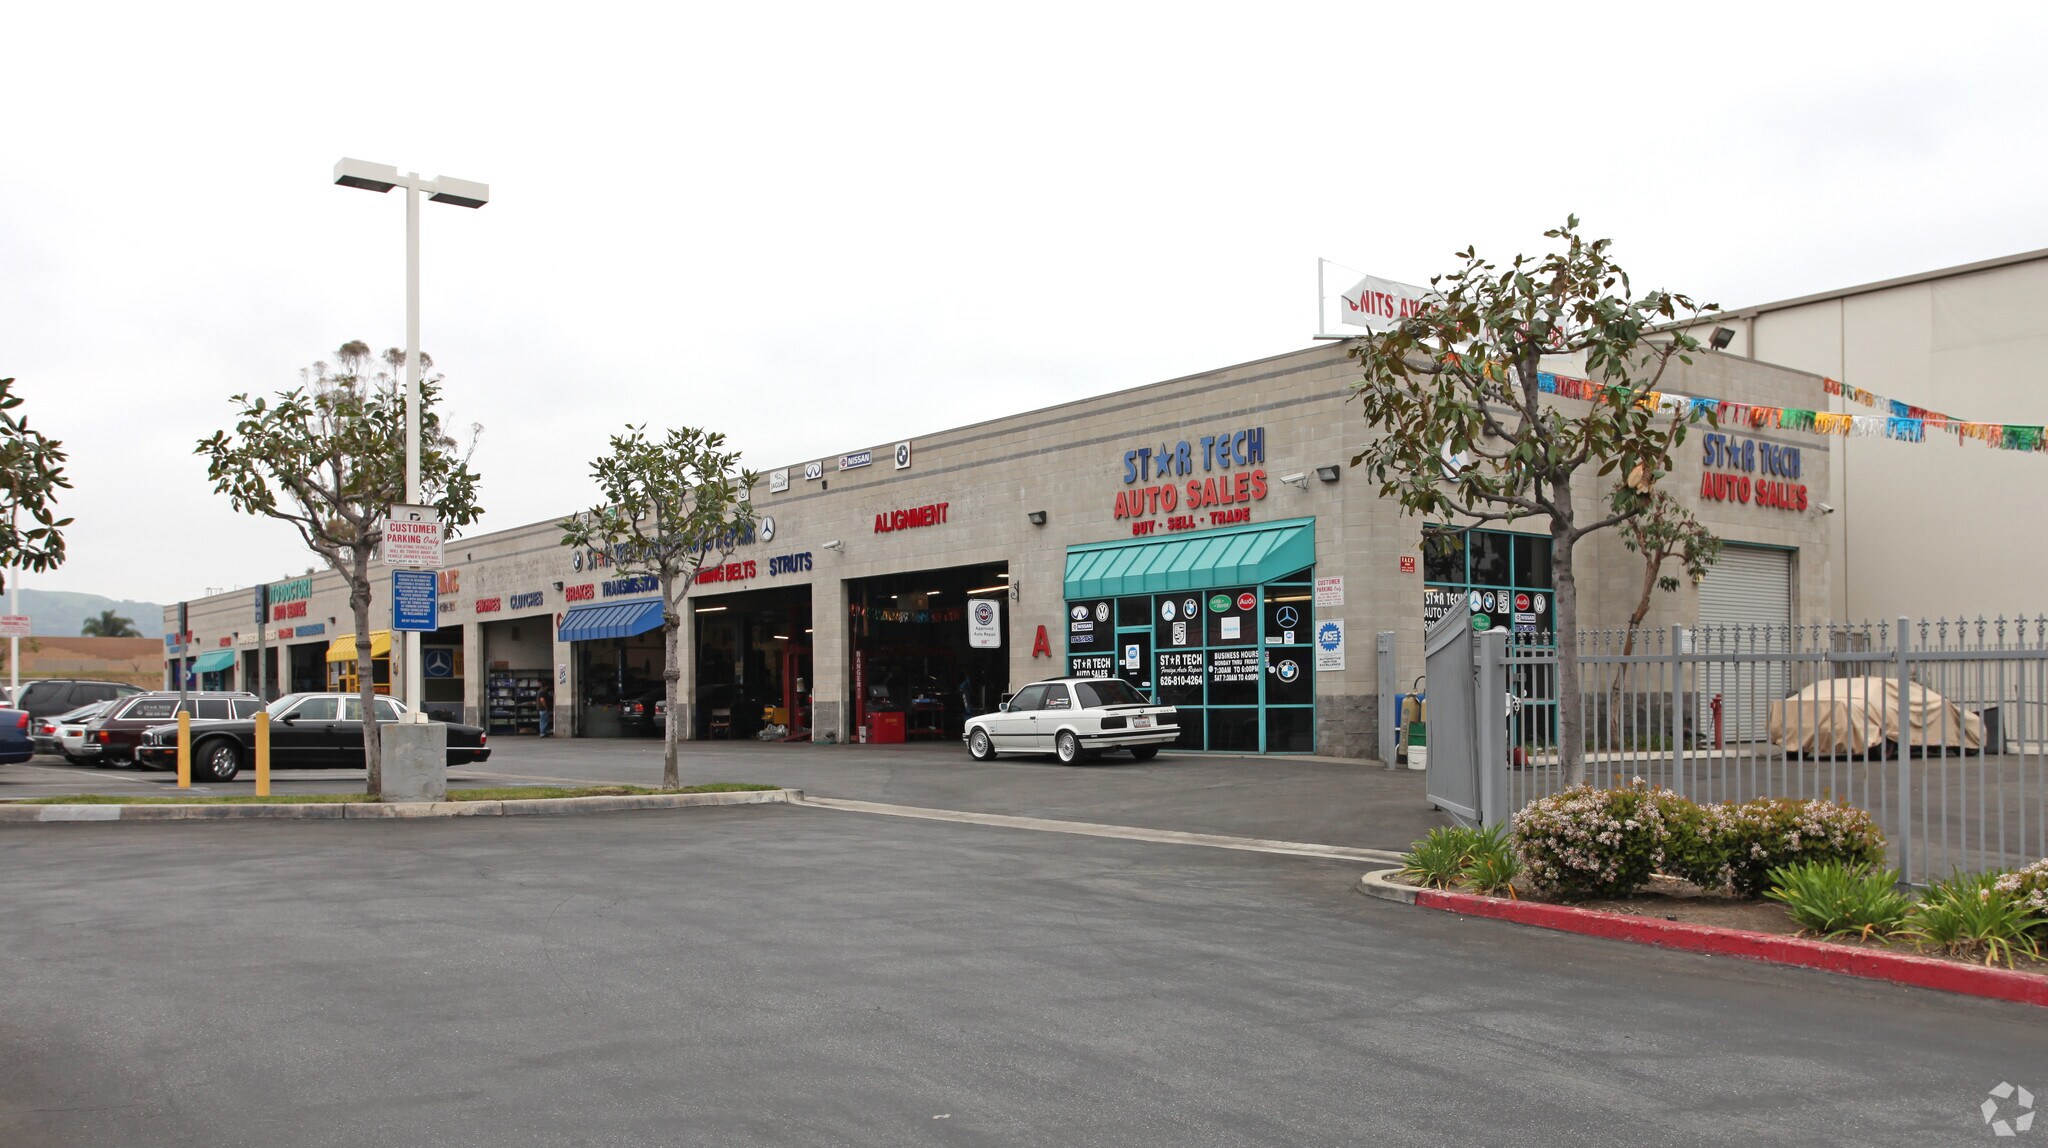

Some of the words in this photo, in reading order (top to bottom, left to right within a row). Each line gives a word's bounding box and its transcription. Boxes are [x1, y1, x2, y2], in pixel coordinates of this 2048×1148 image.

[1200, 427, 1264, 471] TECH
[848, 452, 869, 465] NISSAN
[1760, 442, 1800, 479] TECH
[770, 480, 786, 490] JAGUAR
[1701, 472, 1751, 503] AUTO
[1755, 479, 1808, 511] SALES
[1114, 483, 1177, 519] AUTO
[1186, 470, 1268, 509] SALES
[874, 502, 949, 533] ALIGNMENT
[1133, 520, 1155, 535] BUY
[1167, 515, 1195, 530] SELL
[1209, 507, 1250, 525] TRADE
[390, 522, 437, 534] CUSTOMER
[387, 534, 421, 544] PARKING
[423, 536, 439, 547] Only
[693, 564, 724, 585] TIMING
[726, 560, 757, 582] BELTS
[769, 551, 812, 577] STRUTS
[510, 591, 543, 609] CLUTCHES
[565, 583, 594, 602] BRAKES
[476, 597, 501, 614] ENGINES
[1424, 607, 1442, 618] AUTO
[1032, 625, 1052, 658] A
[1321, 630, 1338, 641] ASE
[1092, 658, 1111, 669] TECH
[1182, 654, 1202, 665] TECH
[1214, 651, 1240, 660] BUSINESS
[1091, 669, 1108, 678] SALES
[1160, 675, 1203, 686] 626-810-4264
